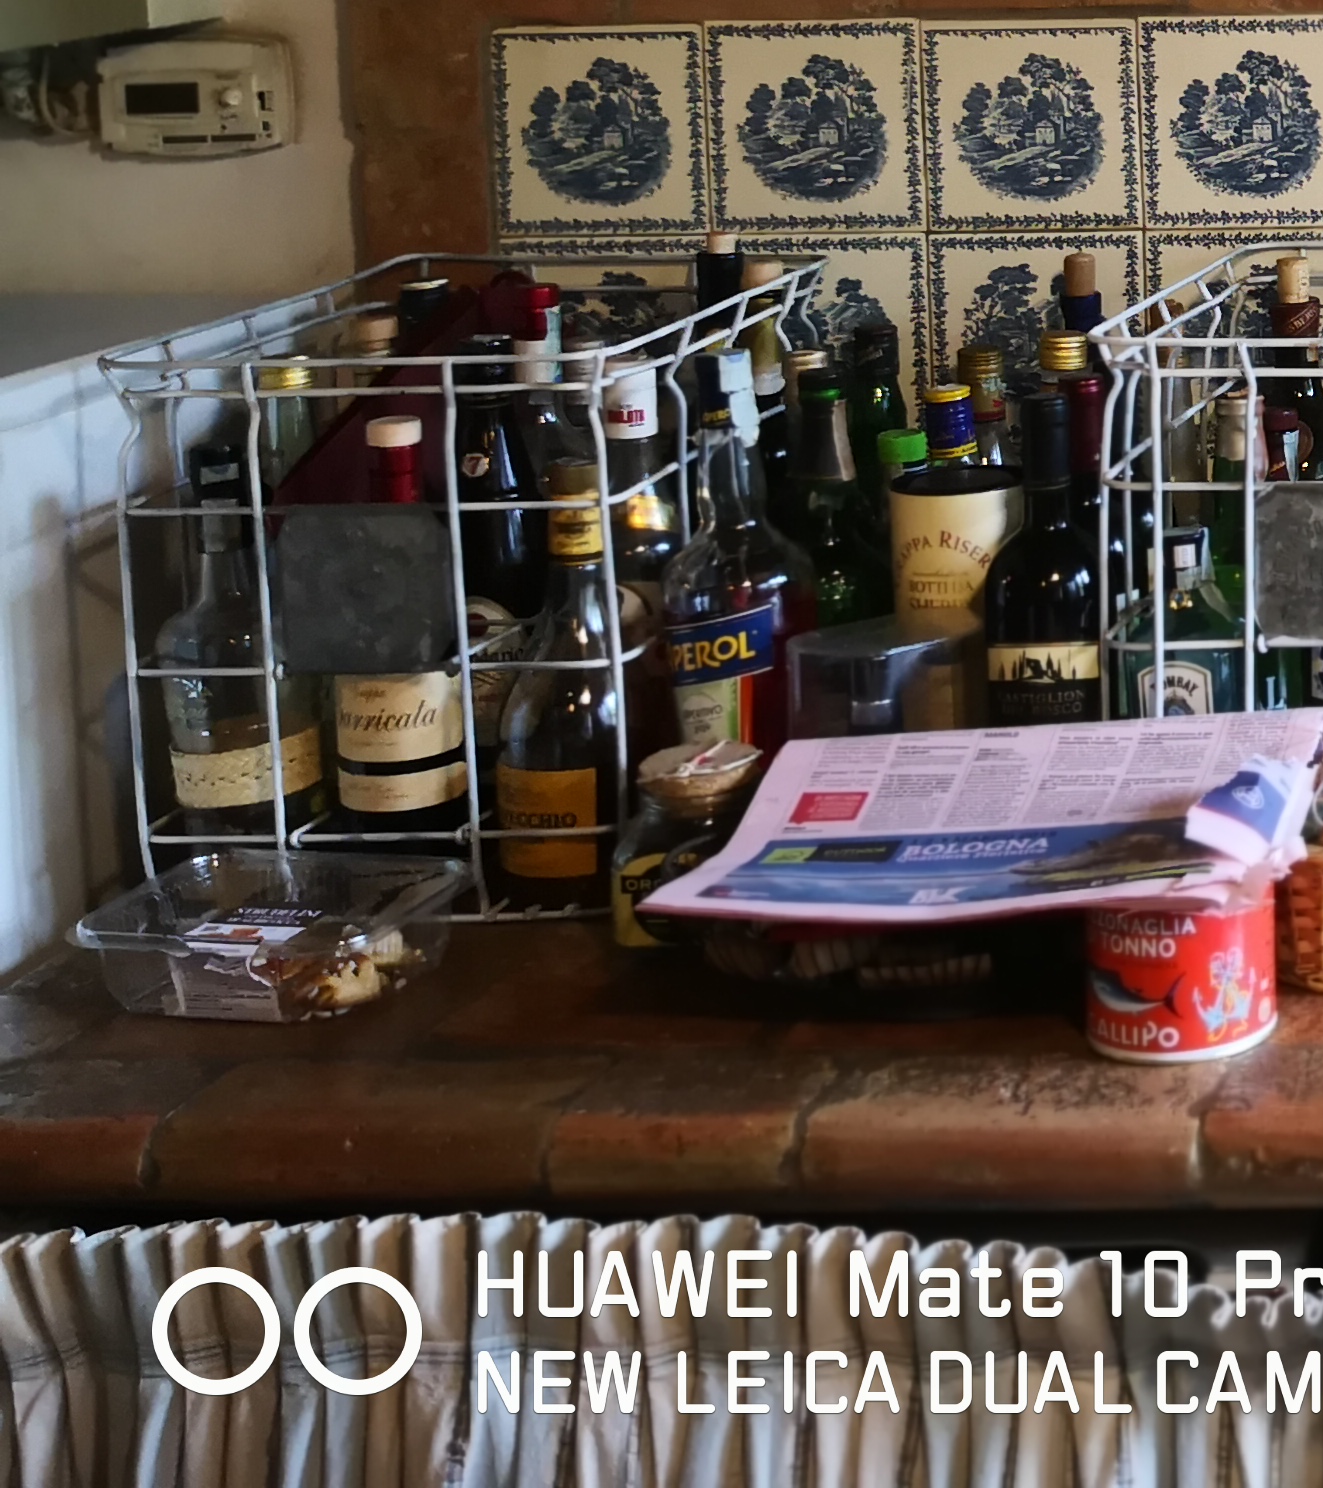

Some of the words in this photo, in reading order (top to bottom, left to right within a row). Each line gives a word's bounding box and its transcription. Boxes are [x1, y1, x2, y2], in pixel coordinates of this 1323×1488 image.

[939, 529, 992, 569] RISER
[669, 630, 756, 672] PEROL
[901, 837, 1050, 858] BOLOGNA
[1097, 1018, 1180, 1049] ALLIPO
